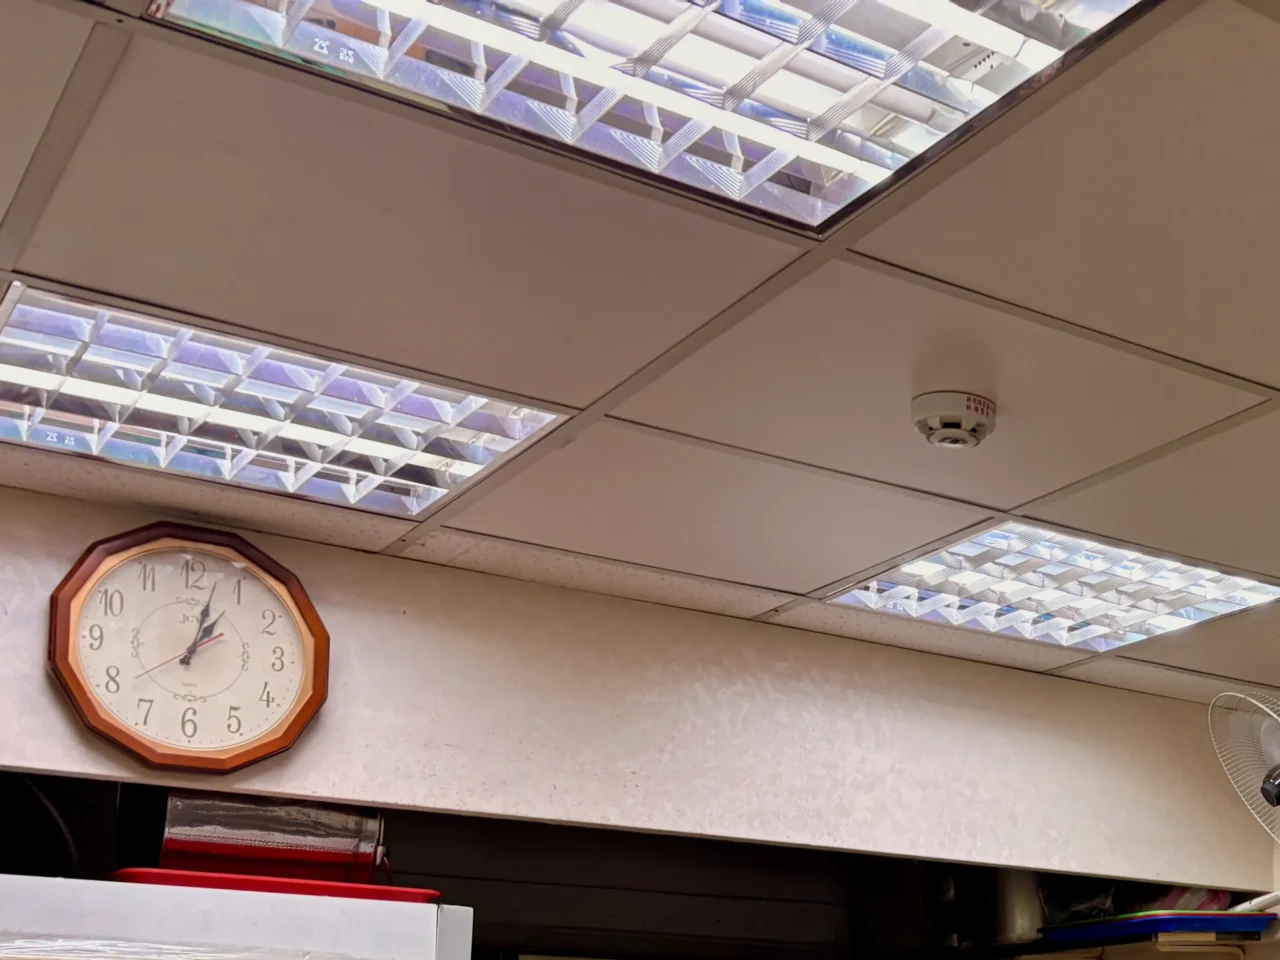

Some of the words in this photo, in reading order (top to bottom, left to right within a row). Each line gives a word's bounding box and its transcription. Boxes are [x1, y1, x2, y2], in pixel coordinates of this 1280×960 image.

[138, 561, 156, 592] 11
[180, 559, 207, 590] 12
[99, 588, 124, 617] 10
[232, 577, 243, 605] 1
[261, 609, 278, 635] 2
[89, 624, 104, 651] 9
[271, 647, 285, 672] 3
[105, 666, 120, 693] 8
[259, 682, 275, 708] 4
[137, 698, 154, 726] 7
[181, 707, 198, 738] 6
[226, 706, 242, 734] 5
